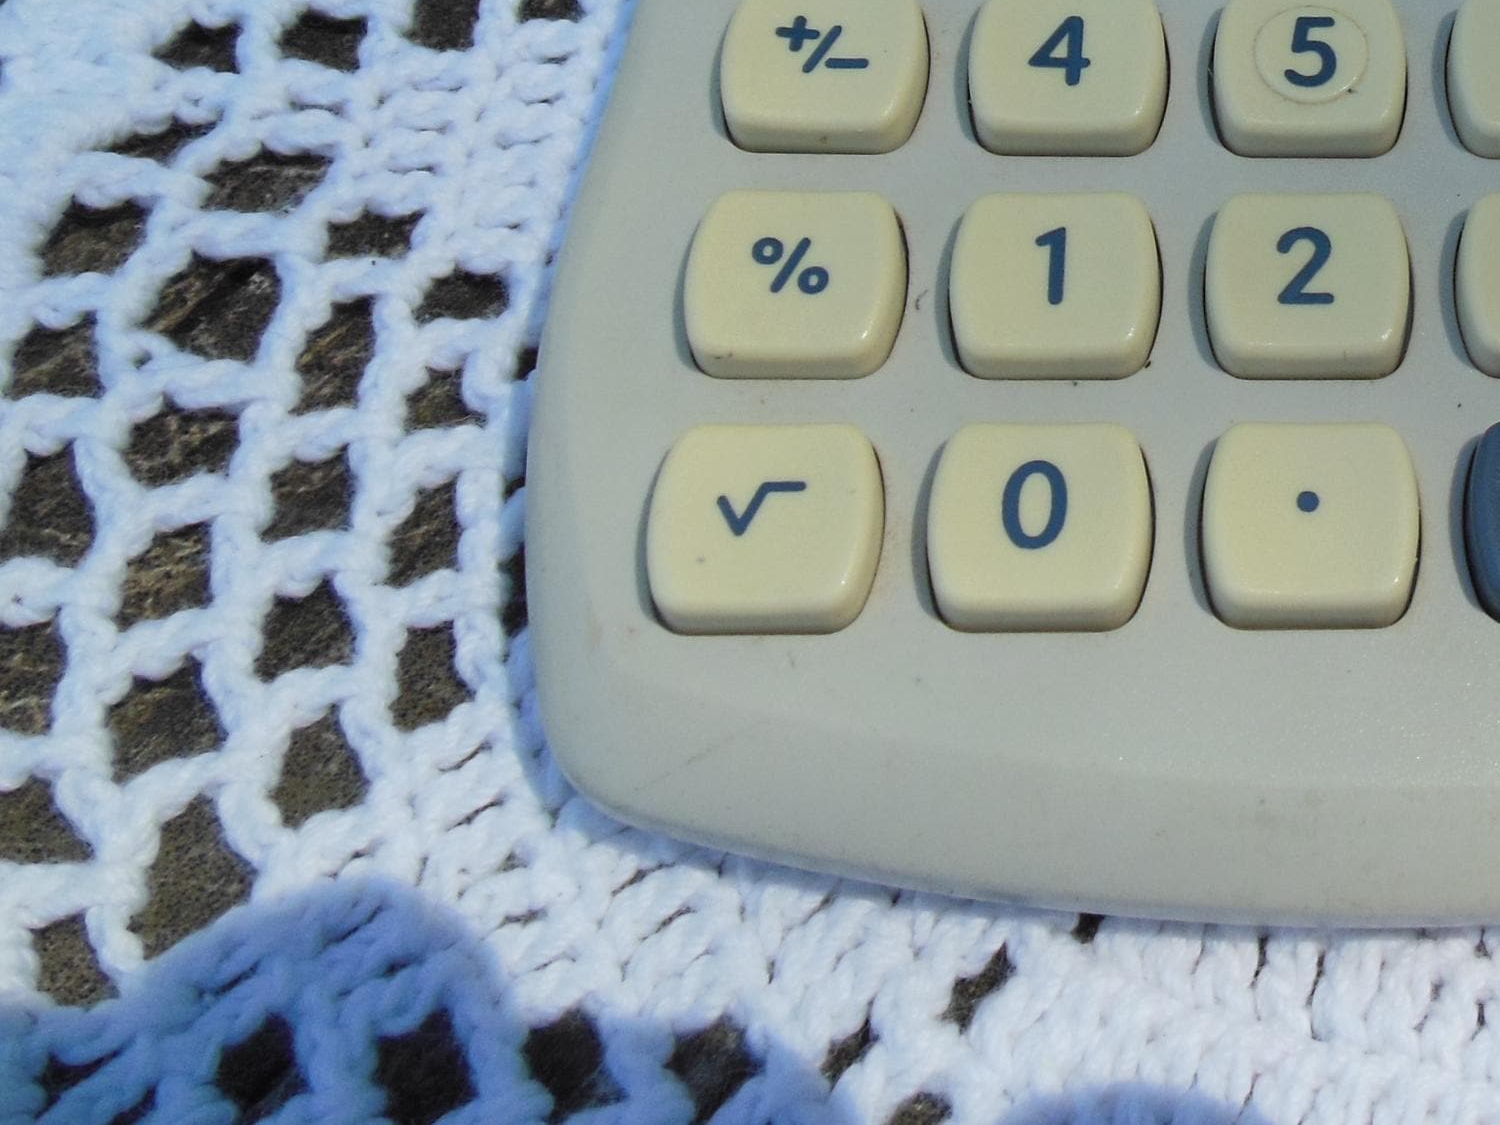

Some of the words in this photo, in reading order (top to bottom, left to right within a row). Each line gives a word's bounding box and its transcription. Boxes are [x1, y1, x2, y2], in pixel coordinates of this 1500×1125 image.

[1028, 16, 1091, 87] 4
[1284, 17, 1337, 88] 5
[1035, 227, 1067, 306] 1
[1277, 227, 1335, 306] 2
[1002, 460, 1068, 550] 0
